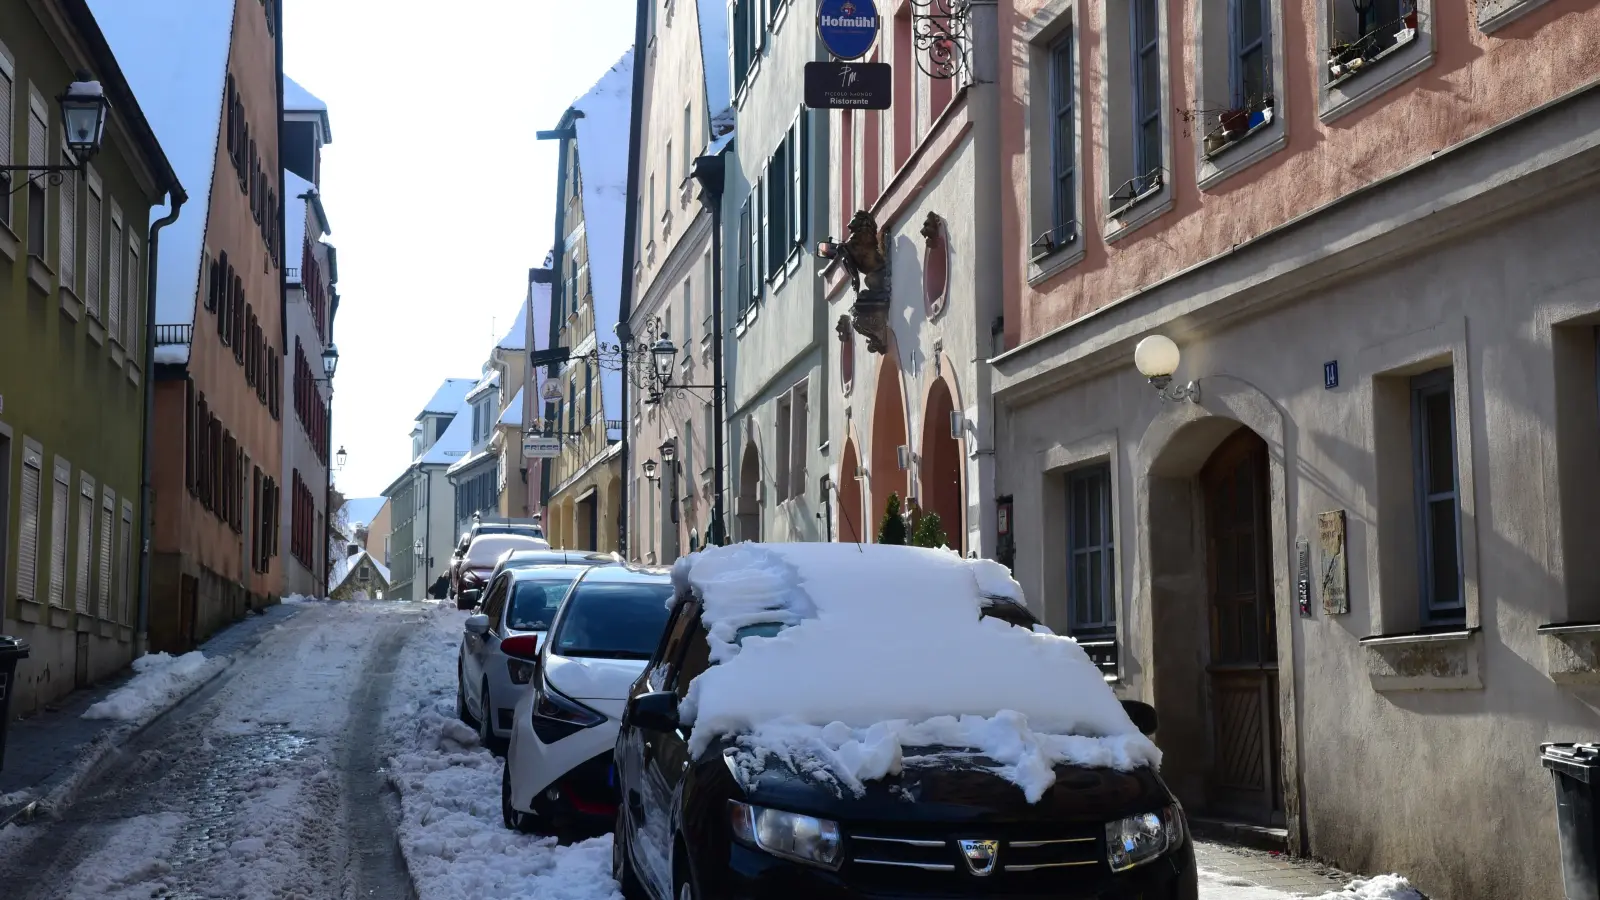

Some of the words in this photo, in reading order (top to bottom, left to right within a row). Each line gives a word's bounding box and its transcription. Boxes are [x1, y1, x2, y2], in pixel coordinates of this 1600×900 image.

[821, 15, 875, 28] Hofmühl
[829, 97, 869, 105] Ristorante
[1326, 364, 1335, 385] 14
